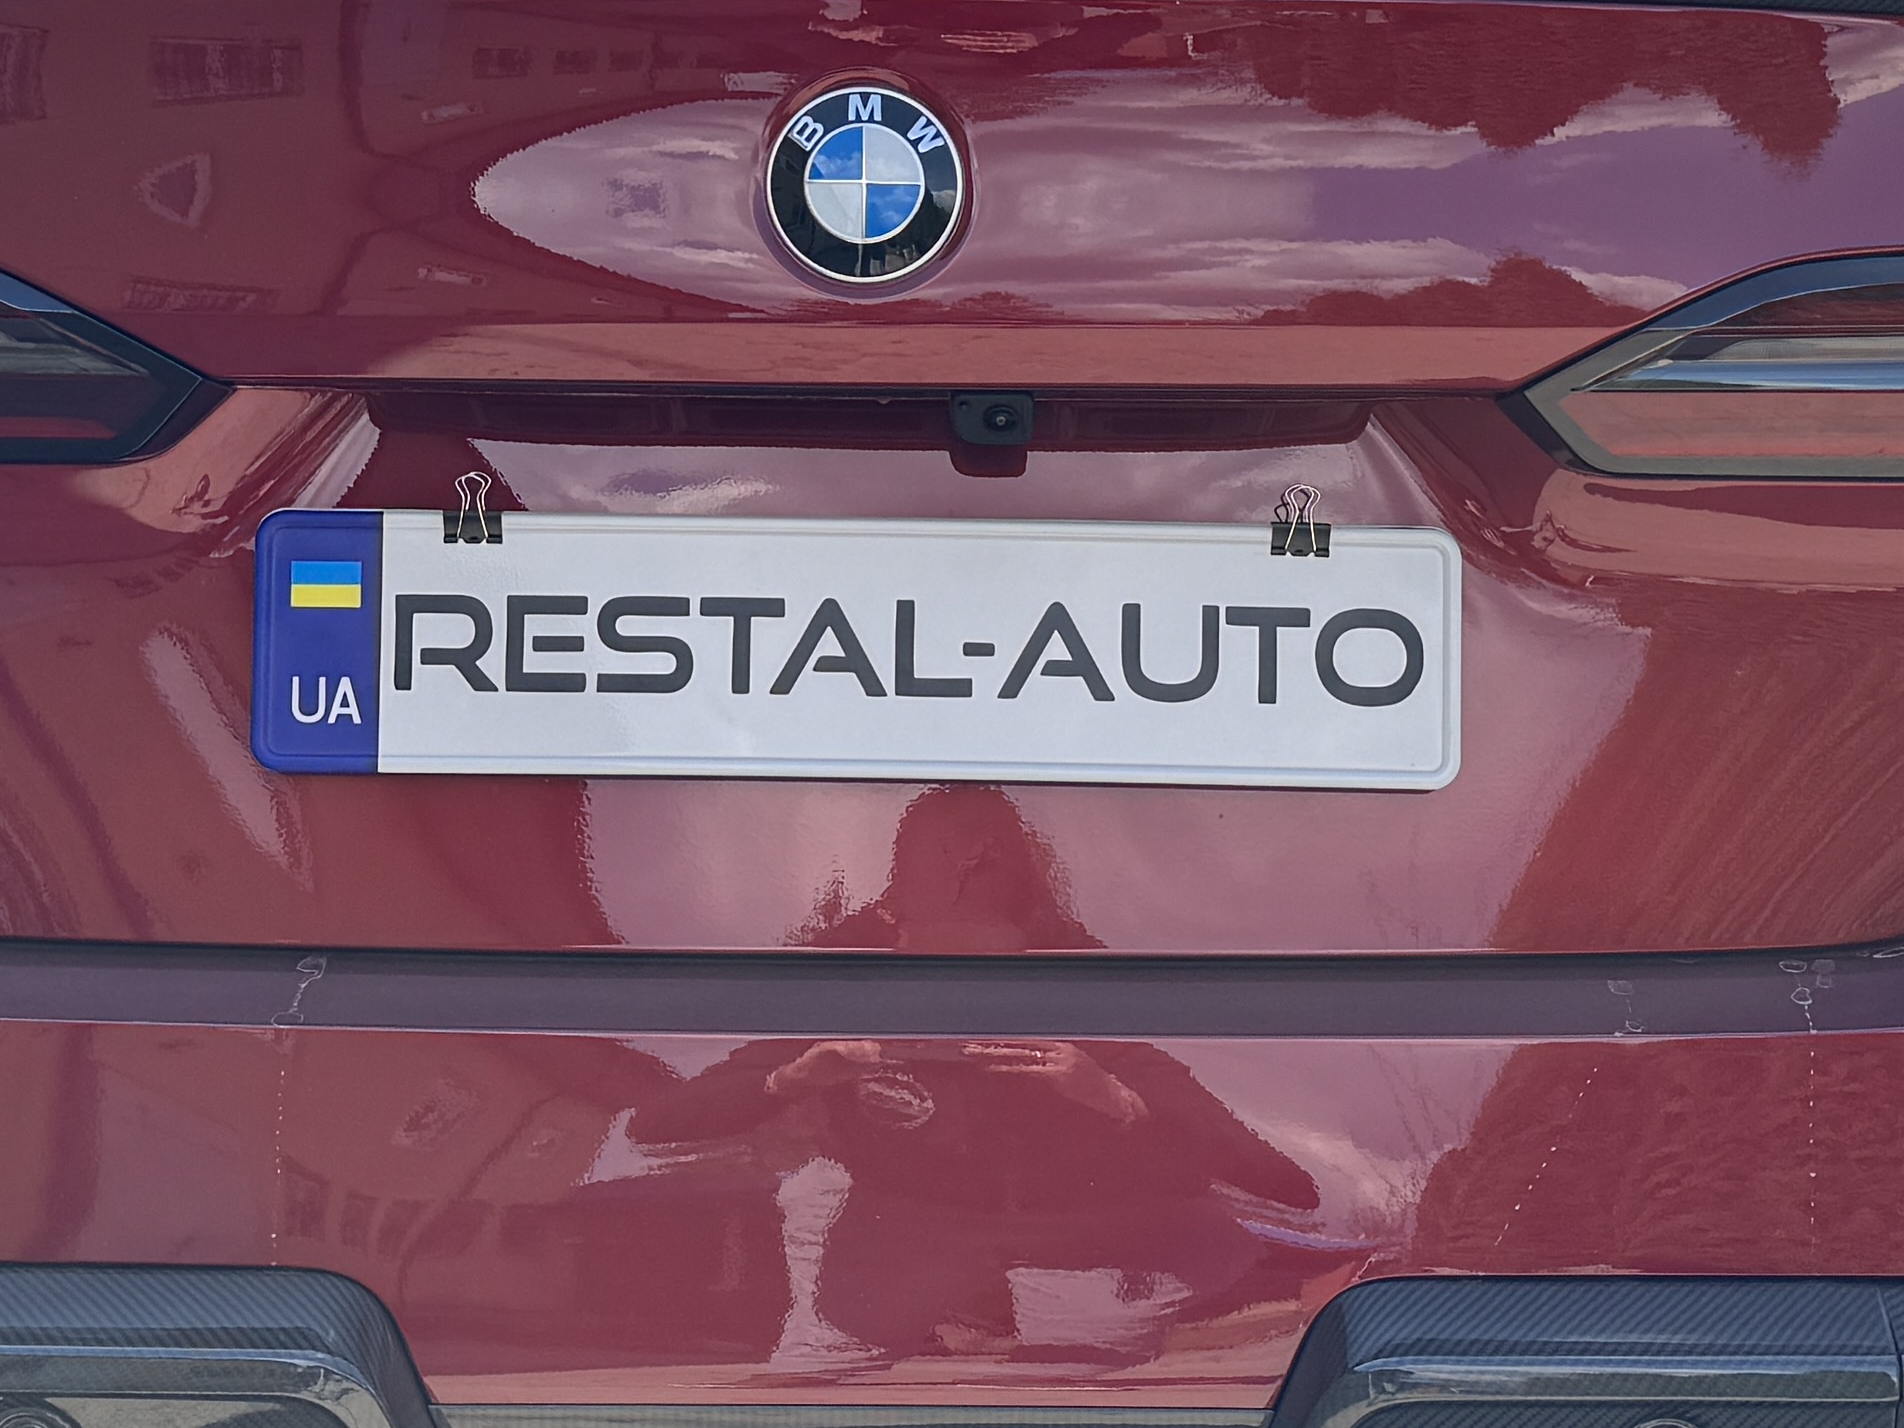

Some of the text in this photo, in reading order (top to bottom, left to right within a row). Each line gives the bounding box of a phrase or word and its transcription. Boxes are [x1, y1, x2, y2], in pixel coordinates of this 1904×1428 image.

[790, 93, 945, 153] BMW
[393, 593, 1425, 707] RESTAL-AUTO
[291, 676, 362, 725] UA
